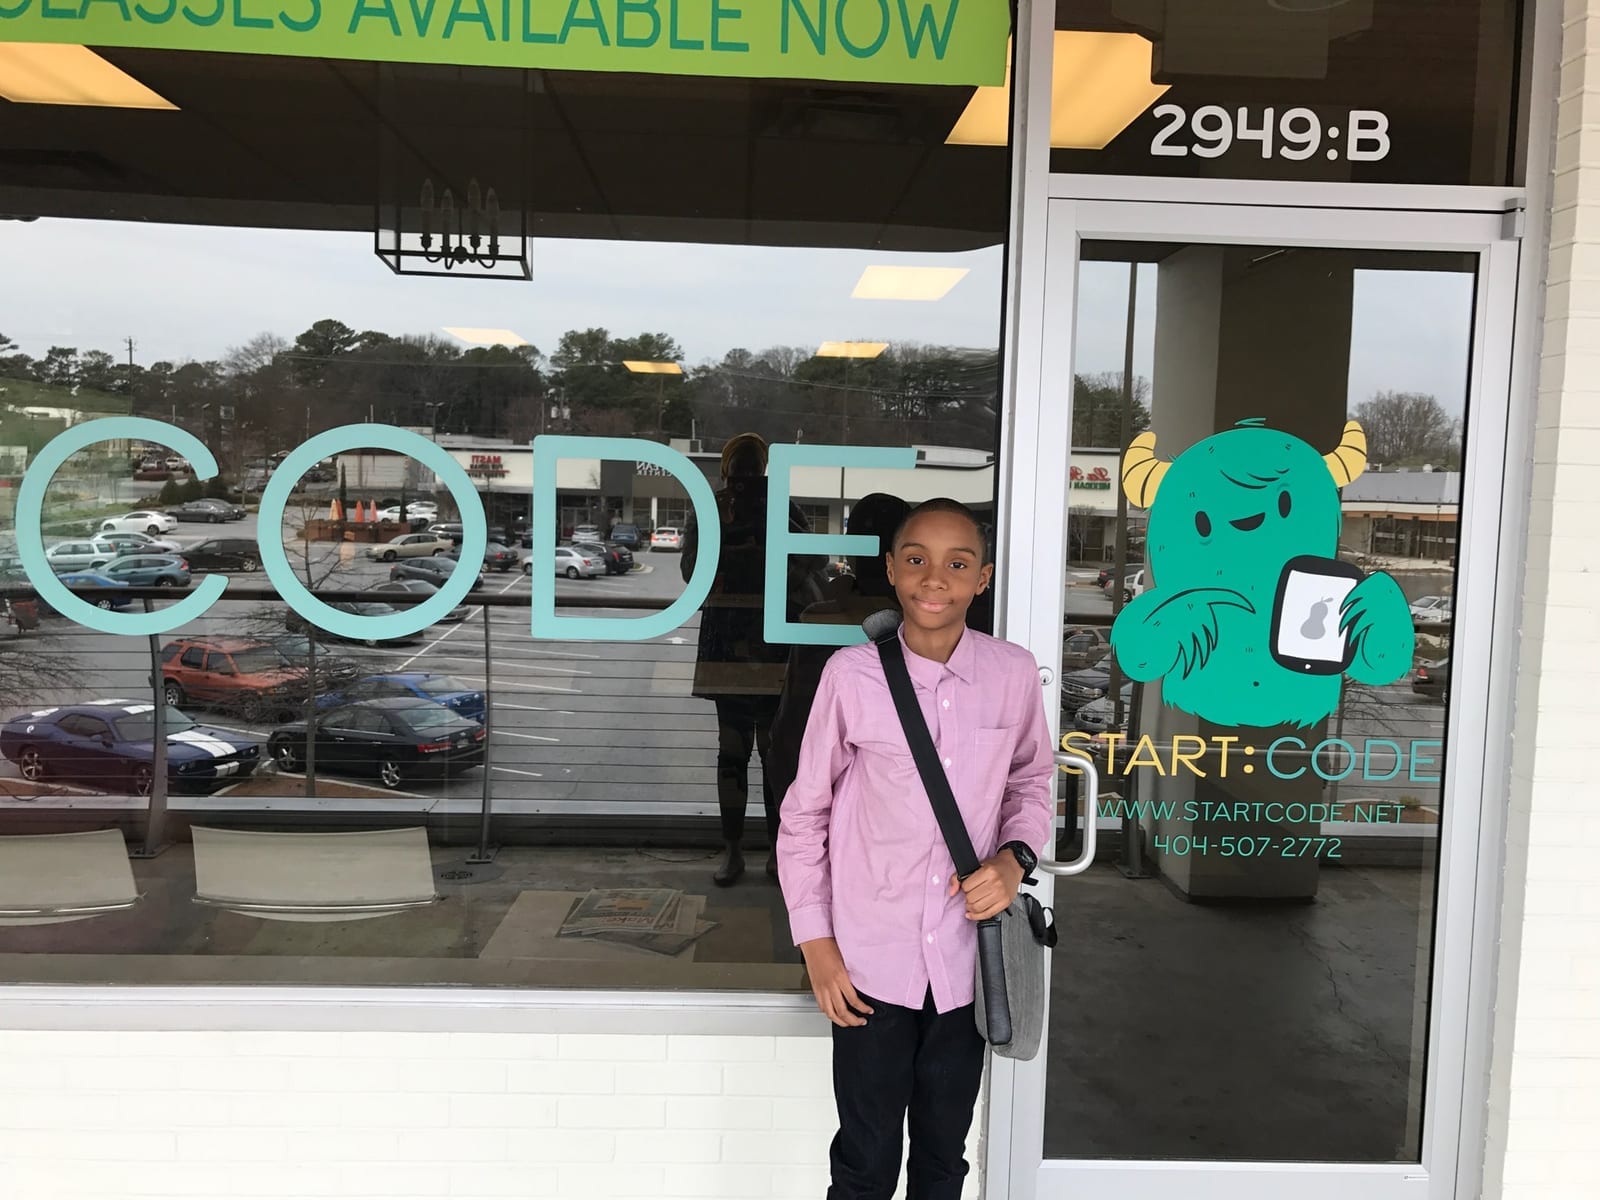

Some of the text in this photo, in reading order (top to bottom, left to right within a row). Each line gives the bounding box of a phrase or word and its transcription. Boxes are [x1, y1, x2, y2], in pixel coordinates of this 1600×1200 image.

[347, 0, 749, 52] AVAILABLE
[780, 0, 960, 60] NOW
[1150, 103, 1391, 162] 2949:B
[15, 415, 918, 646] CODE
[1097, 799, 1405, 825] WWW.STARTCODE.NET
[1154, 834, 1342, 858] 404-507-2772
